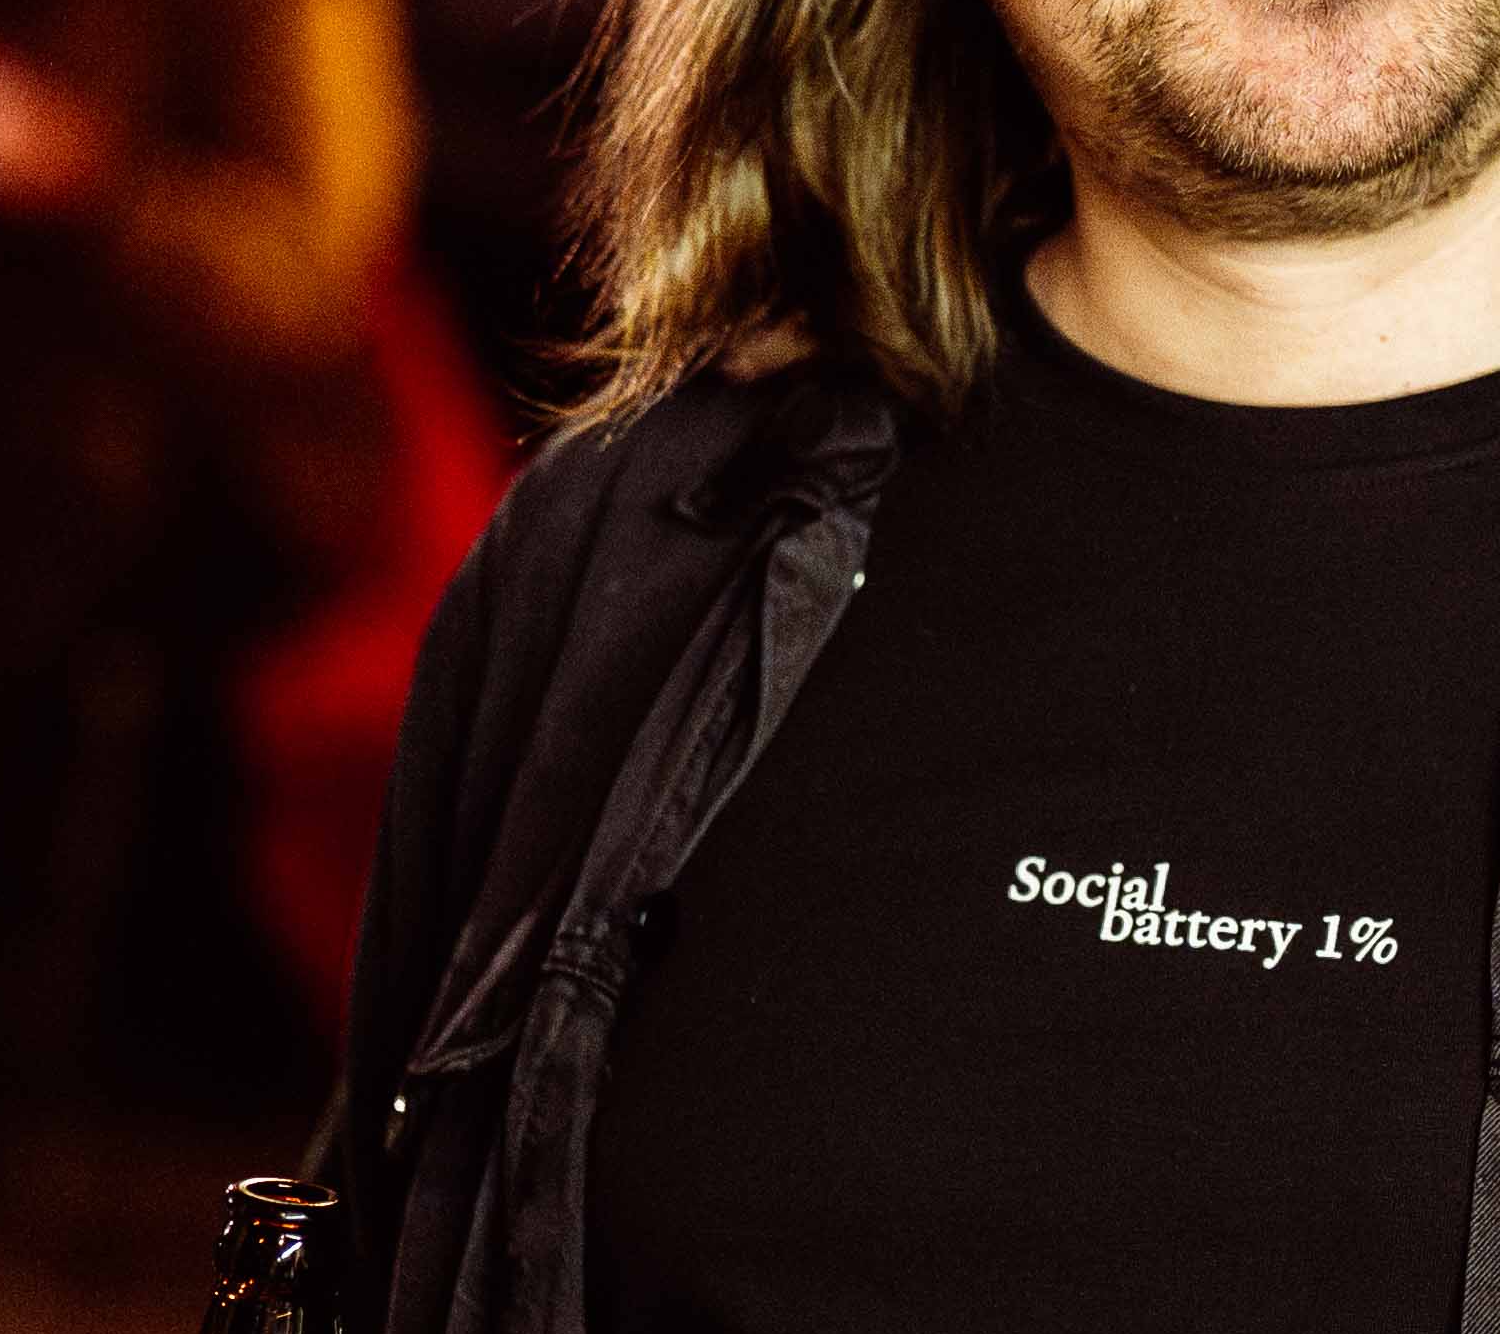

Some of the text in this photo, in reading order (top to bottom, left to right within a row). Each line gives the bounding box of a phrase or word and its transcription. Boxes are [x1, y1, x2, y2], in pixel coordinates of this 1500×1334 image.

[1007, 855, 1171, 913] Social
[1099, 891, 1399, 969] battery 1%
